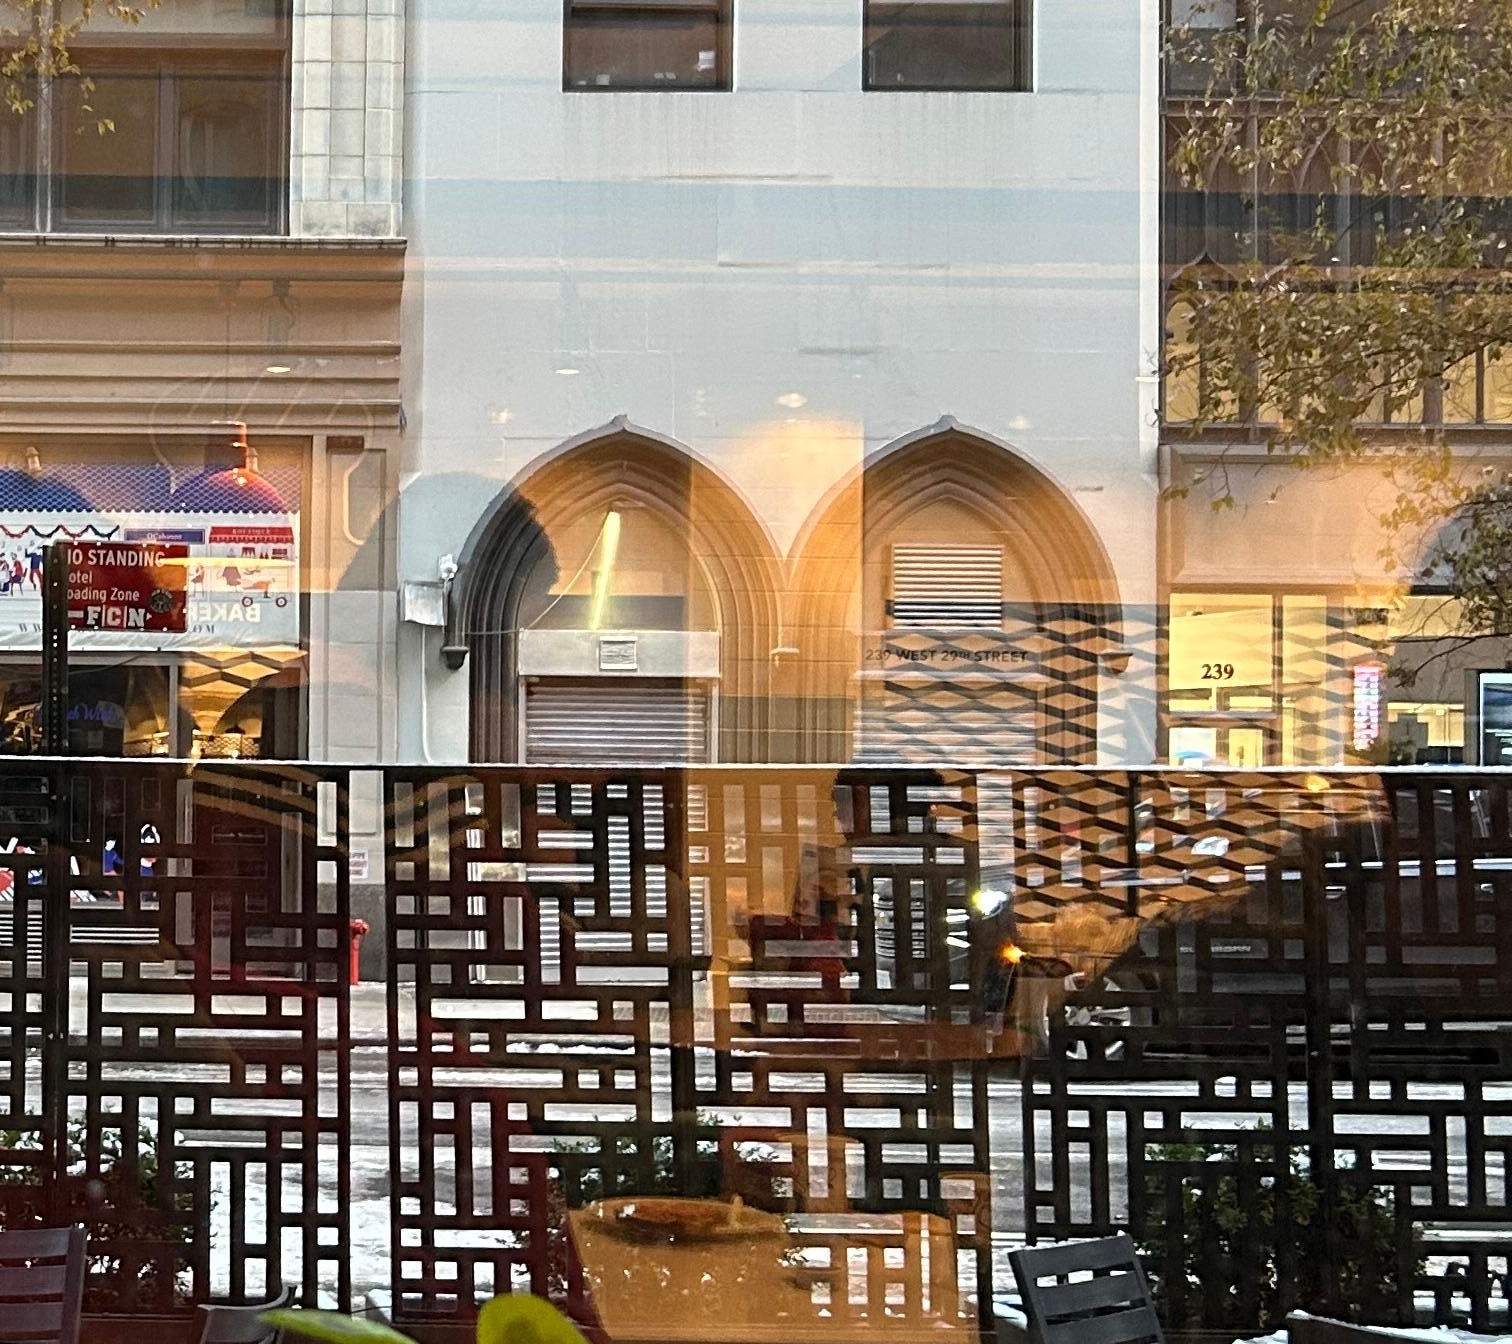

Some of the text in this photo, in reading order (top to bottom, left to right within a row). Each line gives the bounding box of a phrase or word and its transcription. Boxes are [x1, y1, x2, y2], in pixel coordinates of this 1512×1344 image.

[88, 549, 166, 567] STANDING
[69, 570, 93, 584] otel
[68, 588, 107, 603] oading
[110, 587, 140, 601] Zone
[896, 649, 937, 661] WEST
[974, 650, 1029, 663] STREET
[1200, 663, 1234, 680] 239
